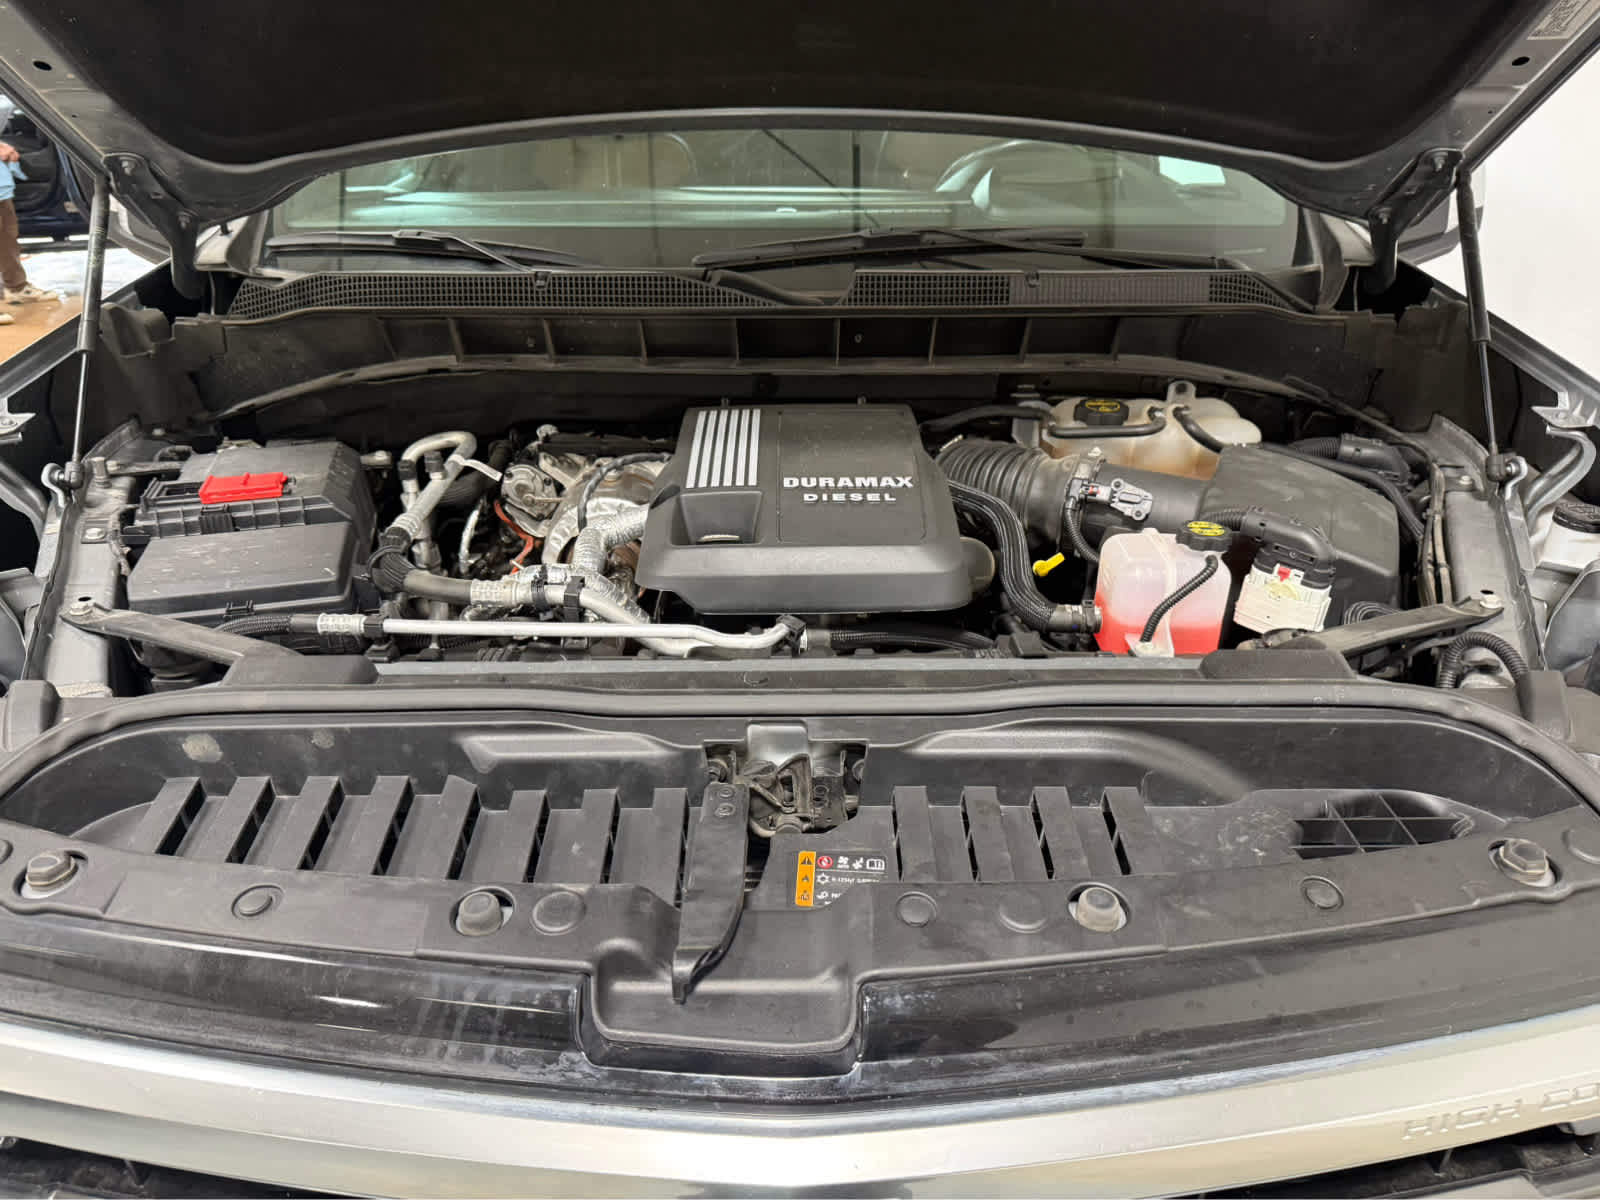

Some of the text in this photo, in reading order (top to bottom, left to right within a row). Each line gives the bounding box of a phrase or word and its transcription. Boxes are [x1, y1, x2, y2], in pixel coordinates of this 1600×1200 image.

[783, 476, 914, 488] DURAMAX
[803, 493, 896, 502] DIESEL
[1402, 1097, 1524, 1141] HIGH
